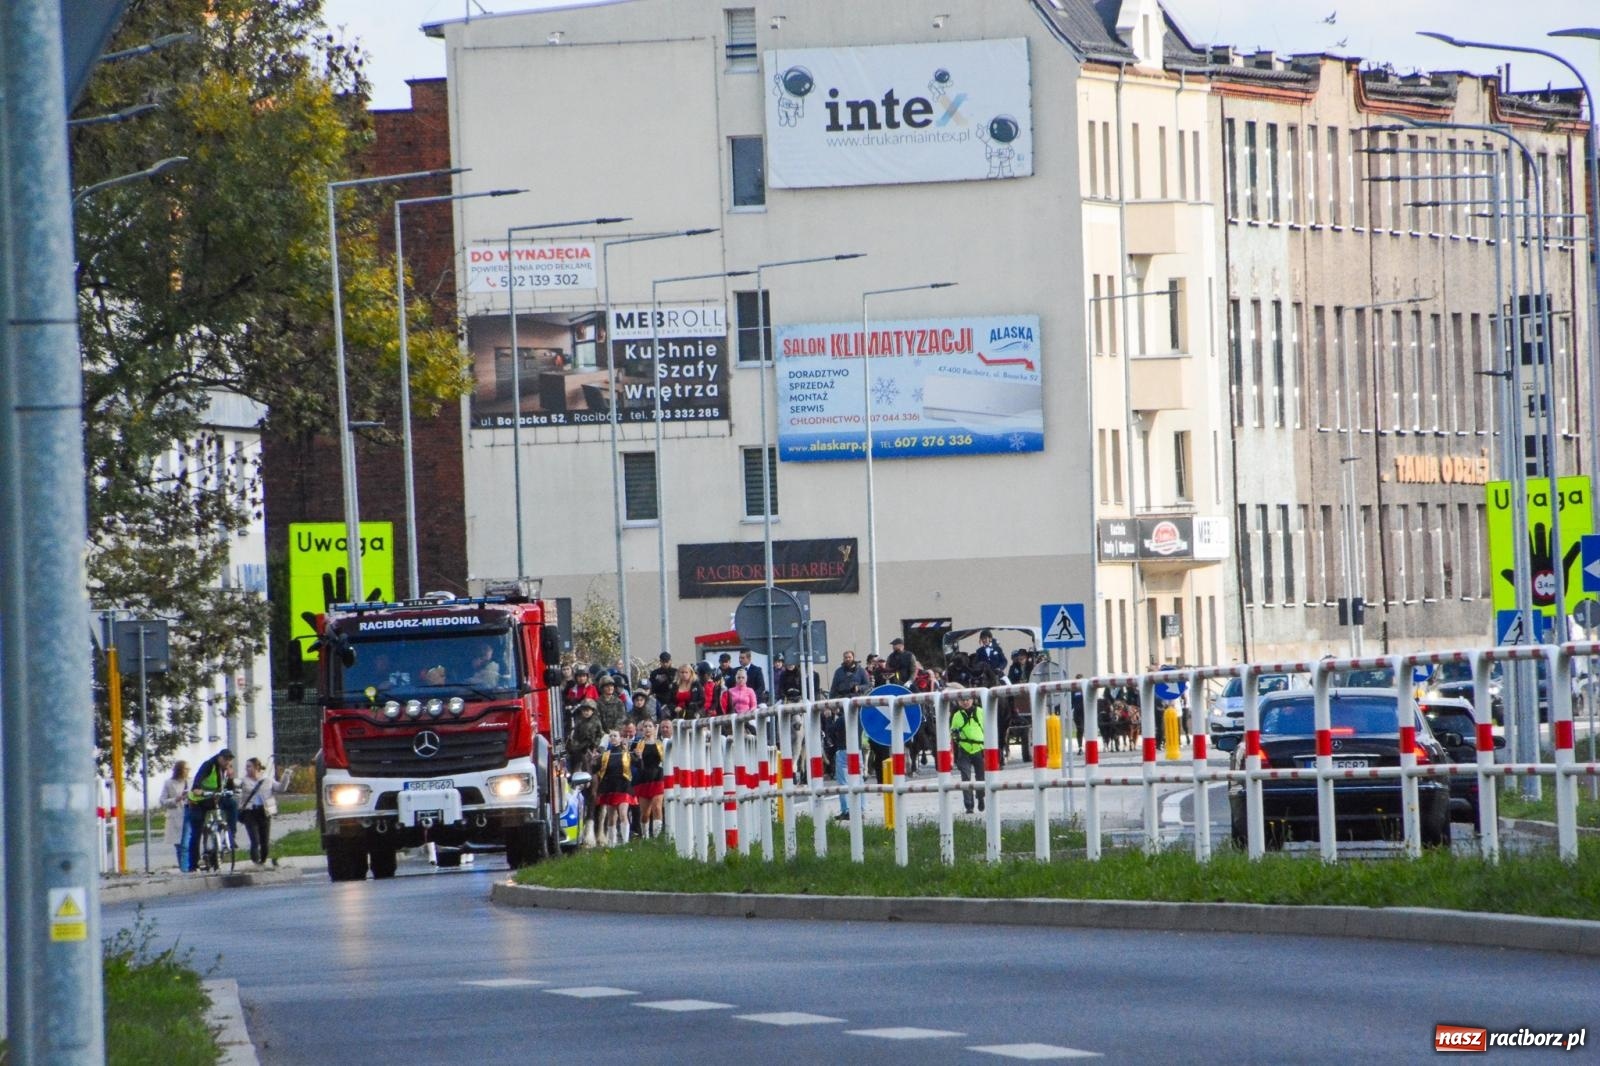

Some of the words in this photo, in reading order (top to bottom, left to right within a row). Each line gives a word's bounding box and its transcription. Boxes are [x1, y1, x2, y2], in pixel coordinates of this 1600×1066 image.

[825, 88, 968, 132] intex
[826, 129, 970, 147] www.drukarniaintex.pl
[471, 250, 494, 263] DO
[471, 264, 534, 273] POWIERZHNIA
[535, 263, 553, 271] POD
[529, 274, 550, 286] 139
[555, 273, 578, 285] 302
[783, 337, 825, 356] SALON
[831, 327, 974, 359] KLIMATYZACJI
[990, 326, 1033, 344] ALASKA
[625, 341, 717, 360] Kuchnie
[658, 360, 718, 381] Szafy
[788, 368, 850, 379] DORADZTWO
[624, 383, 718, 401] Wnętrza
[789, 379, 835, 391] SPRZEDAŻ
[789, 391, 829, 402] MONTAŻ
[481, 417, 494, 426] ul.
[630, 410, 648, 420] tel.
[674, 409, 695, 418] 332
[698, 407, 719, 417] 285
[790, 404, 825, 414] SERWIS
[790, 415, 860, 425] CHŁODNICTWO
[862, 414, 881, 424] (07
[882, 413, 899, 422] 044
[894, 436, 918, 448] 607
[922, 435, 945, 447] 376
[949, 434, 973, 446] 336
[1395, 454, 1439, 484] TANIA
[791, 561, 845, 577] BARBER
[359, 615, 481, 631] RACIBÓRZ-MIEDONIA
